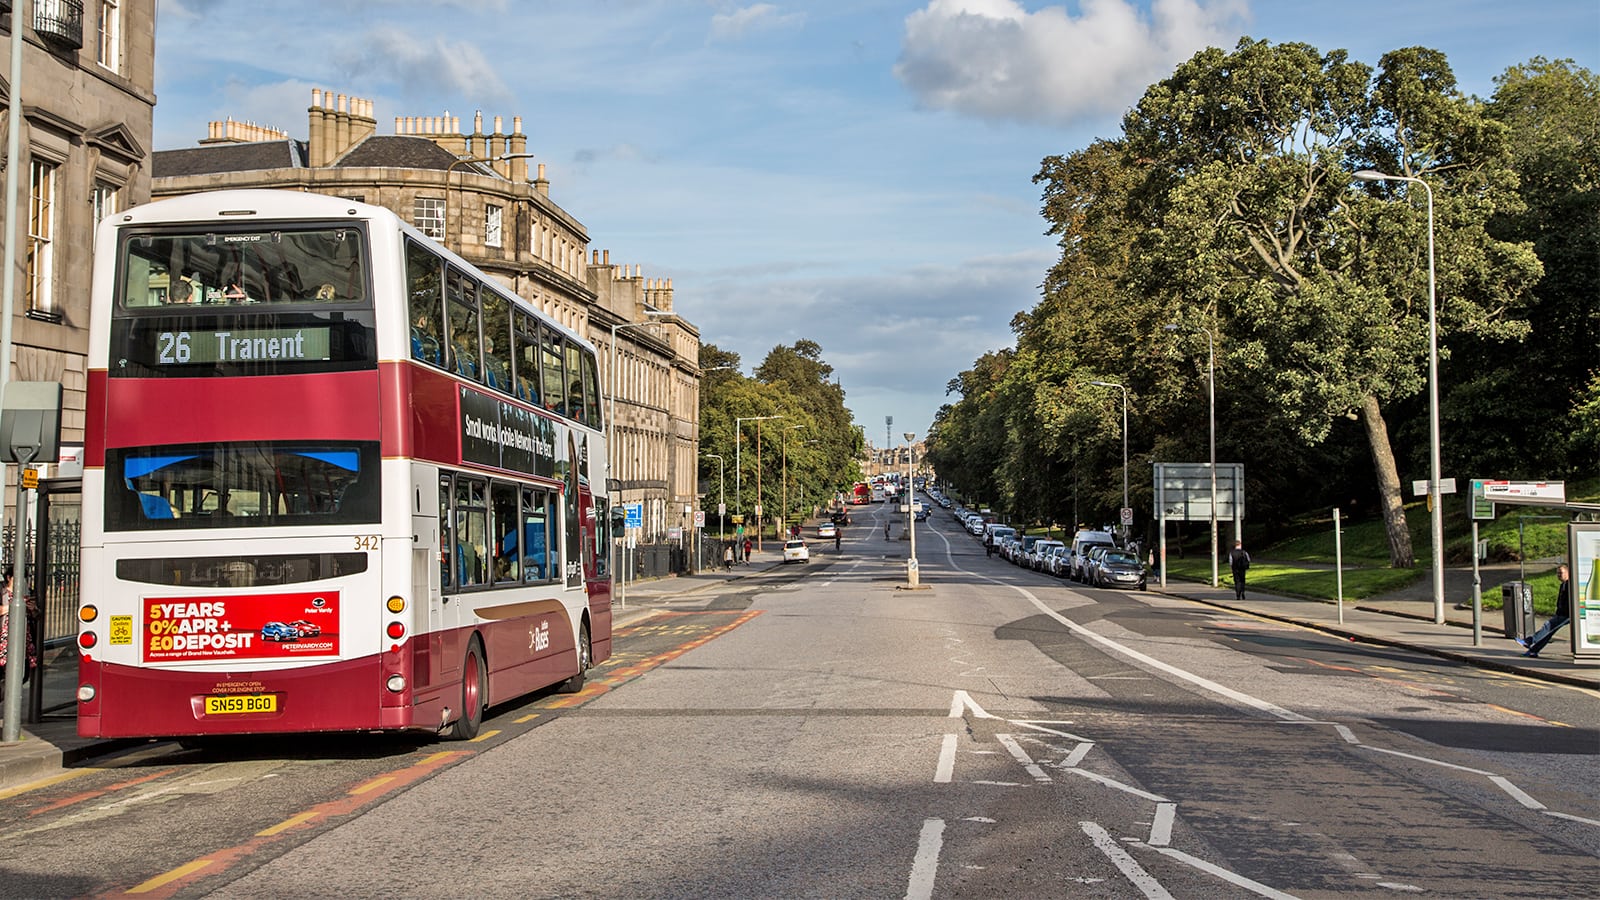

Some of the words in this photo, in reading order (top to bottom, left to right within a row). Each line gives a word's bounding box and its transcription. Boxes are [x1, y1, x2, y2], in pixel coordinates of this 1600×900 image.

[159, 331, 191, 364] 26
[215, 330, 305, 360] Tranent
[465, 414, 481, 437] Small
[354, 535, 378, 550] 342
[282, 642, 333, 650] PETERVARDY.COM
[535, 627, 549, 651] Buses
[211, 699, 243, 711] SN59
[247, 698, 271, 710] BGO
